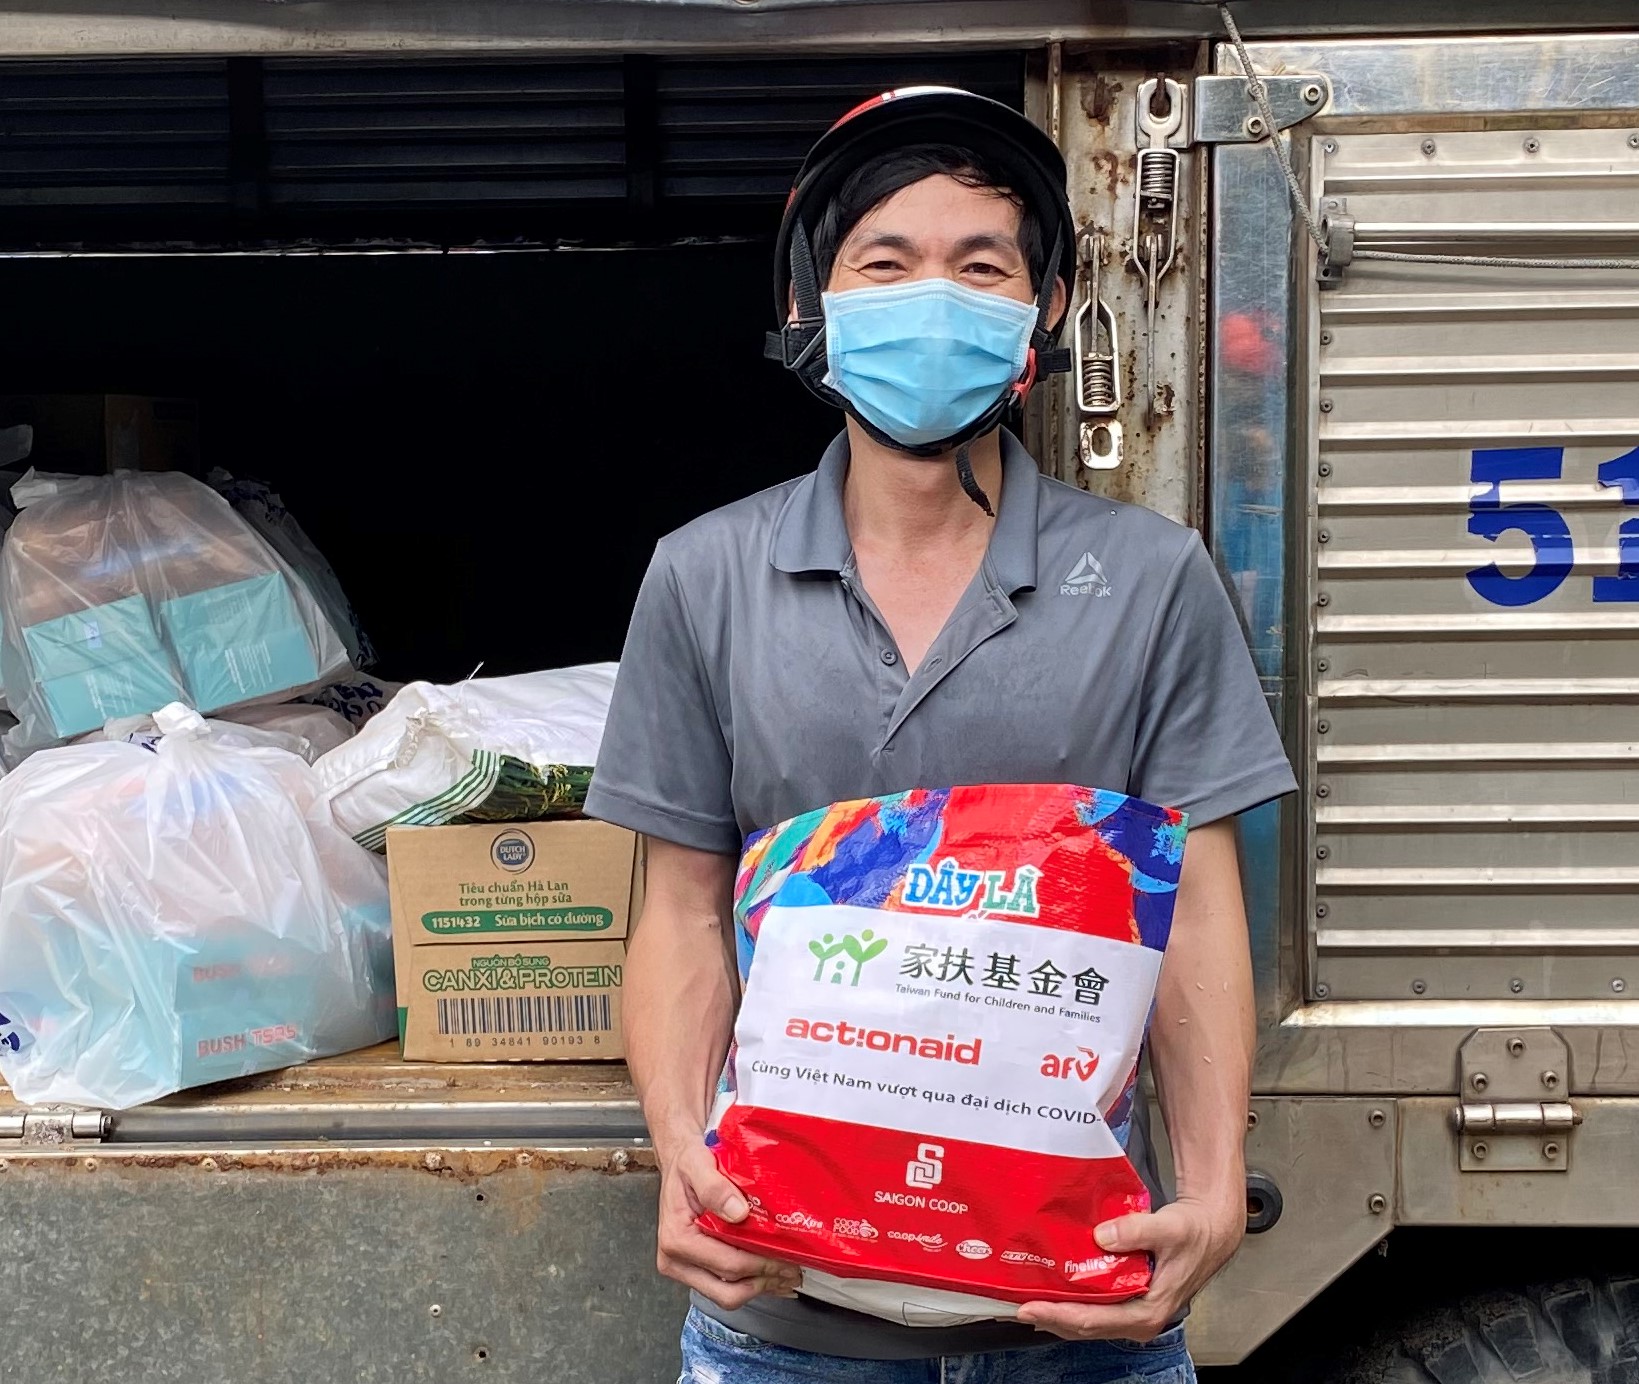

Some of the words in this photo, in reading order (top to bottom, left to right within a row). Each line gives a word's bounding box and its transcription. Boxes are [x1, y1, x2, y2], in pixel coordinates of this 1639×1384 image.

[499, 845, 526, 854] DUTCH
[459, 882, 484, 894] Tiêu
[527, 880, 544, 892] Hà
[547, 880, 569, 891] Lan
[459, 896, 493, 909] trong
[526, 893, 549, 906] hộp
[432, 915, 481, 929] 1151432
[547, 913, 562, 925] có
[899, 943, 1110, 1006] 家扶基金會
[895, 984, 931, 998] Taiwan
[934, 988, 960, 1001] Fund
[964, 991, 980, 1004] for
[984, 995, 1030, 1012] Children
[1034, 1005, 1055, 1016] and
[1058, 1007, 1101, 1024] Families
[197, 1033, 247, 1058] BUSH
[449, 1037, 455, 1048] 1
[491, 1036, 531, 1047] 34841
[543, 1035, 584, 1046] 90193
[594, 1034, 601, 1045] 8
[752, 1060, 791, 1080] Cùng
[796, 1066, 829, 1086] Việt
[833, 1073, 872, 1091] Nam
[877, 1082, 918, 1099] vượt
[922, 1089, 956, 1106] qua
[960, 1093, 989, 1111] đại
[993, 1099, 1032, 1116] dịch
[874, 1190, 926, 1209] SAIGON
